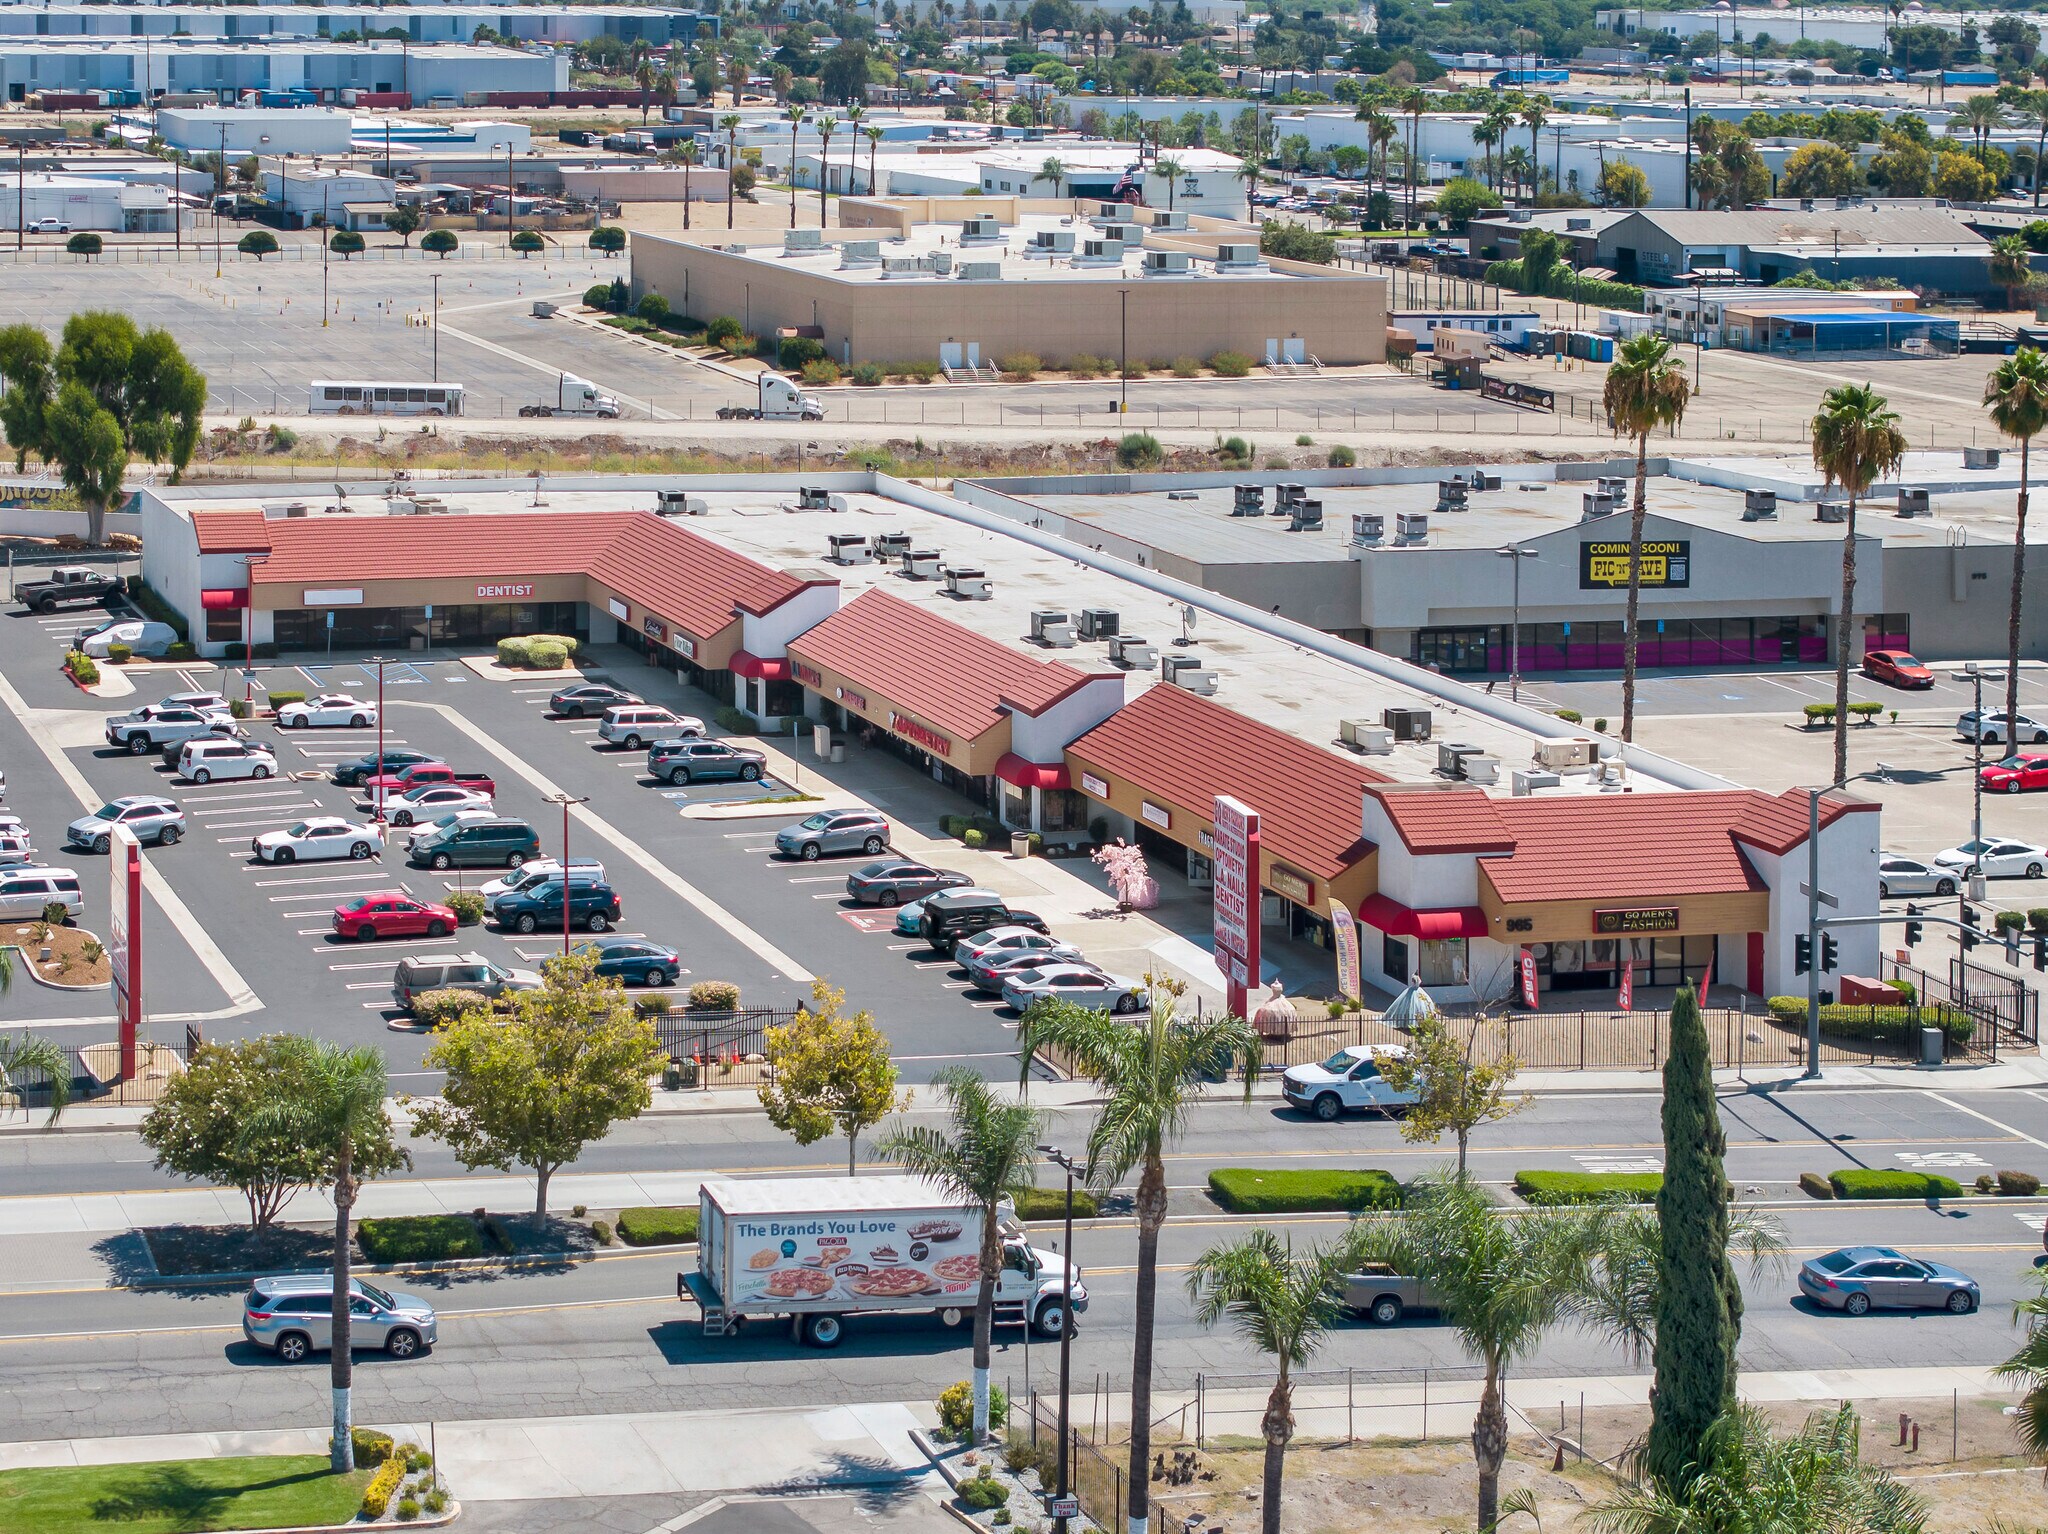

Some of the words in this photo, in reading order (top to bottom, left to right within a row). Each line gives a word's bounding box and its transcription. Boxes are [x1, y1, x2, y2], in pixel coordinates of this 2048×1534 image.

[1642, 251, 1662, 262] STEEL
[1590, 543, 1631, 554] COMIN
[1641, 543, 1680, 553] SOON!
[1594, 561, 1615, 576] PIC
[1638, 560, 1662, 576] AVE
[476, 584, 533, 597] DENTIST
[895, 714, 951, 756] OPTOMETRY
[1215, 847, 1245, 878] OPTOMETRY
[1227, 872, 1245, 899] NAILS
[1215, 884, 1245, 916] DENTIST
[1625, 911, 1641, 919] GQ
[1641, 910, 1673, 918] MEN'S
[1506, 918, 1533, 931] 965
[1622, 918, 1676, 931] FASHION
[738, 1223, 766, 1237] The
[771, 1221, 824, 1236] Brands
[828, 1221, 856, 1234] You
[860, 1222, 896, 1233] Love
[818, 1237, 846, 1246] PAGODA
[837, 1265, 848, 1275] RED
[848, 1263, 868, 1274] BARON
